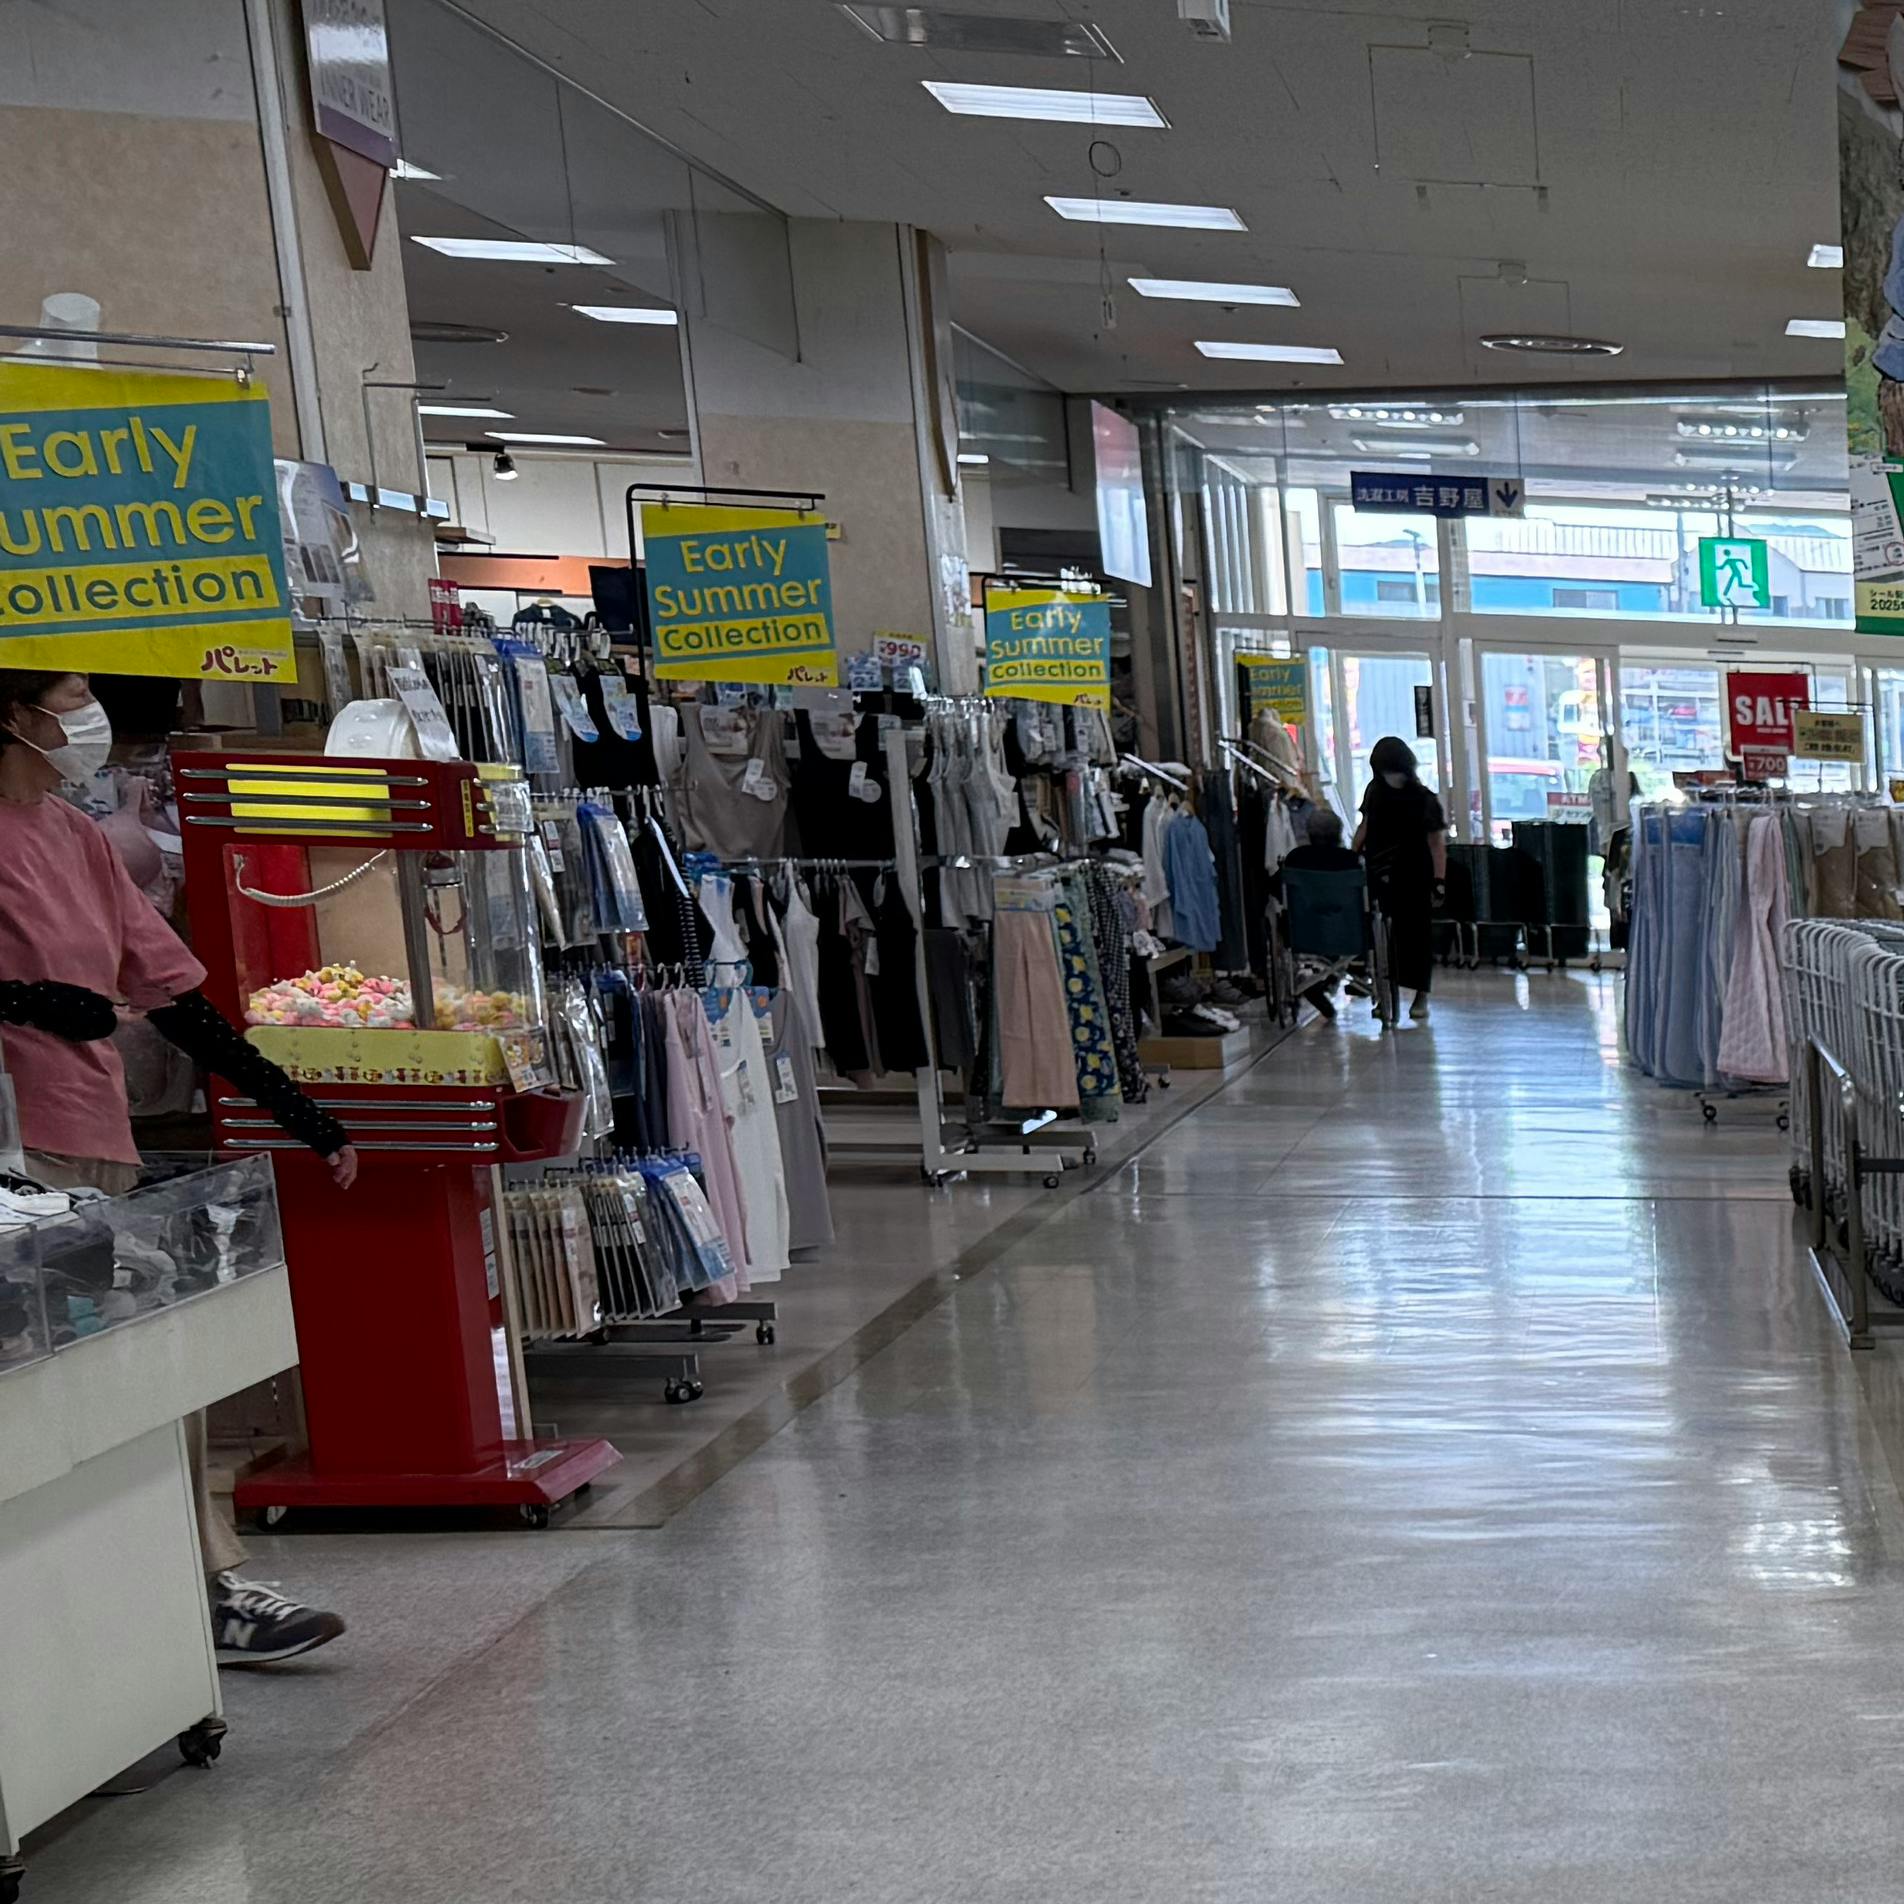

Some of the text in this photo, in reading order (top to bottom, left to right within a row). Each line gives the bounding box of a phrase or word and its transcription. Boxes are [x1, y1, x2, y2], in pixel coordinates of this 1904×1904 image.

[1, 416, 196, 488] Early
[1413, 485, 1484, 509] 吉野屋
[0, 495, 262, 555] ummer
[680, 536, 786, 577] Early
[0, 565, 265, 616] ollection
[655, 578, 822, 620] Summer
[1011, 604, 1082, 633] Early
[663, 619, 822, 652] Collection
[990, 634, 1103, 660] Summer
[201, 645, 278, 676] パレット
[991, 659, 1101, 680] Collection
